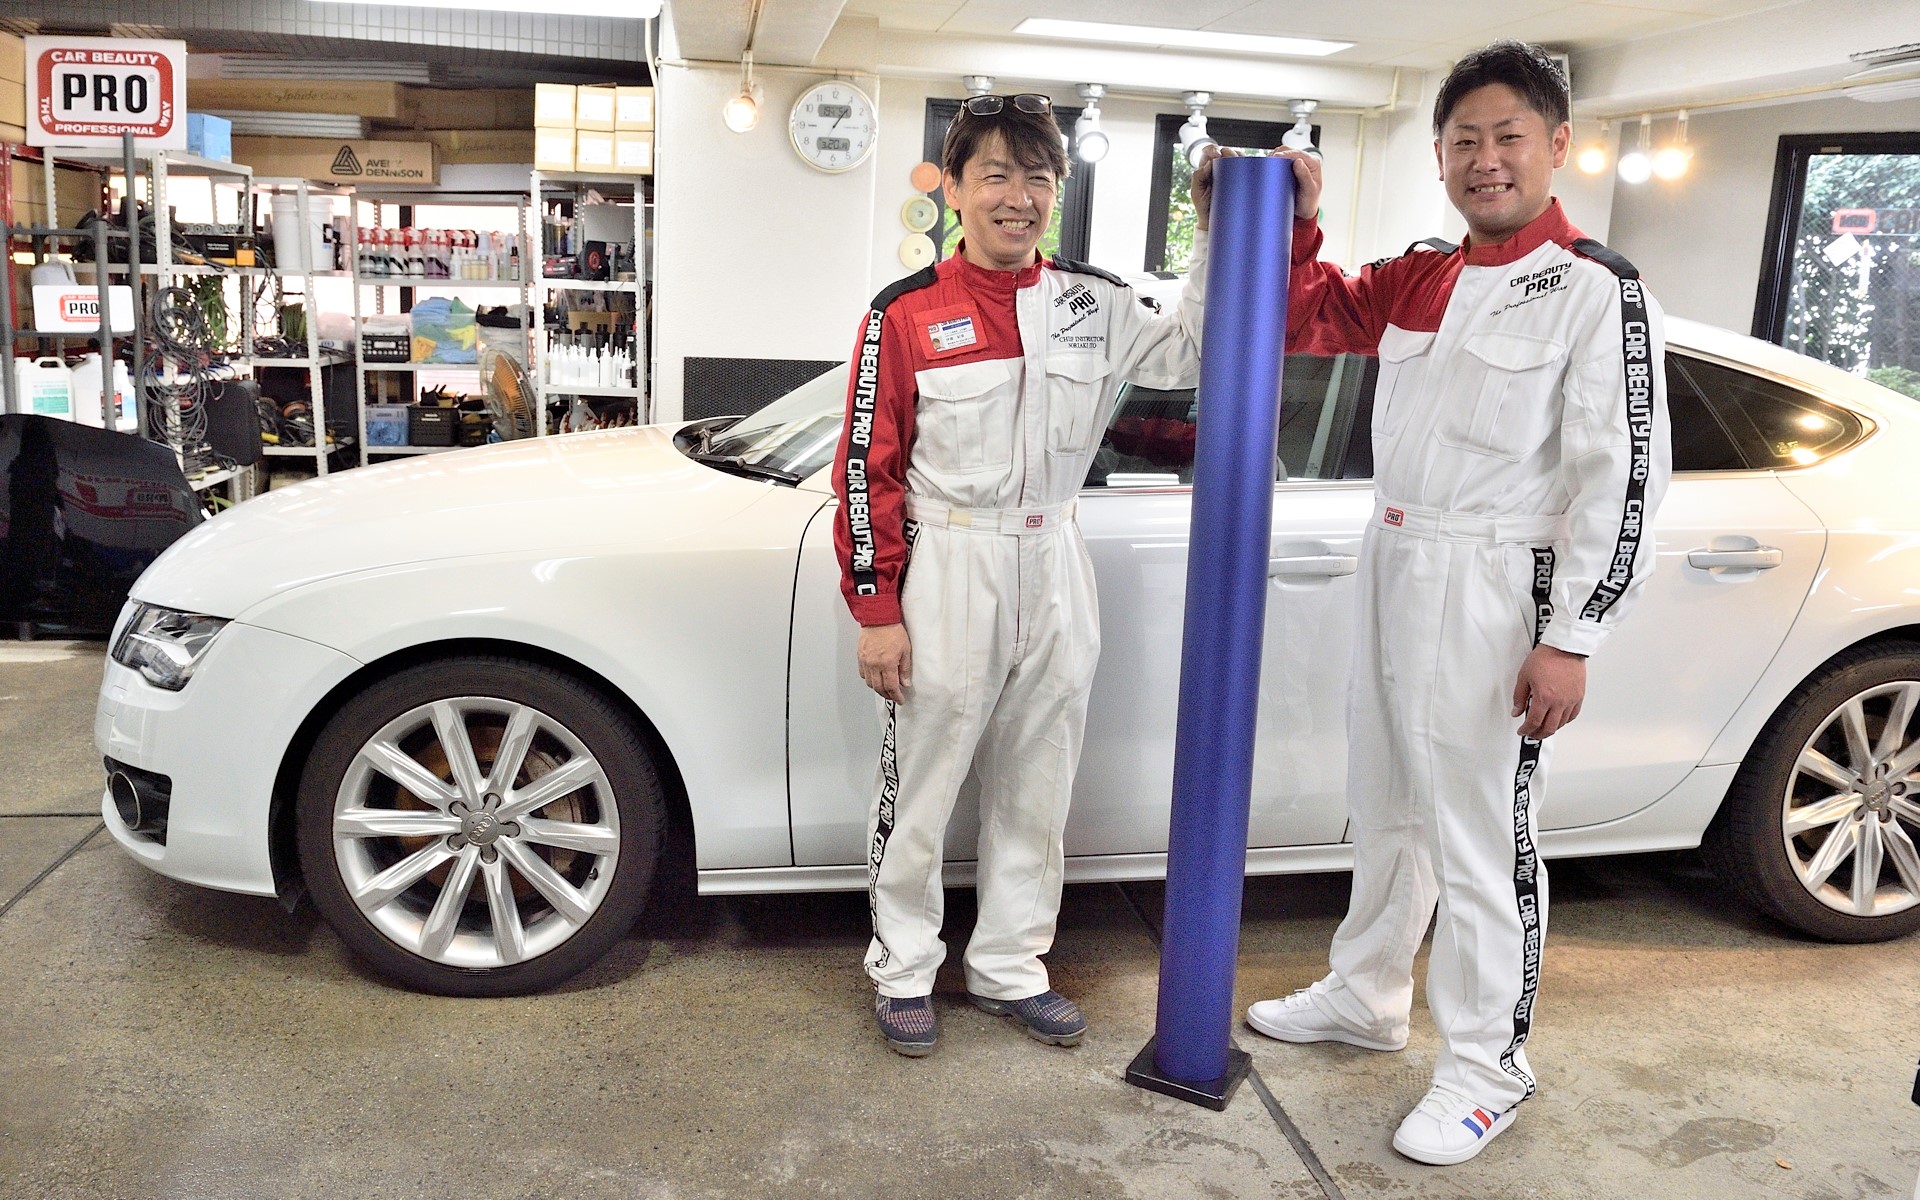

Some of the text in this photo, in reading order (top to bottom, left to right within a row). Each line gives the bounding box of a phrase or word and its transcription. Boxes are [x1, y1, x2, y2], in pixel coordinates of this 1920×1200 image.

[51, 52, 160, 65] CAR BEAUTY
[63, 73, 148, 114] PRO
[40, 97, 52, 125] THE
[159, 100, 171, 128] WAY
[1510, 262, 1572, 288] CAR BEAUTY
[1524, 274, 1562, 296] PRO
[69, 302, 99, 314] PRO
[1054, 283, 1086, 308] CAR BEAUTY
[1068, 290, 1096, 315] PRO
[852, 310, 884, 446] CAR BEAUTY PRO
[1625, 322, 1651, 481] CAR BEAUTY PRO
[848, 458, 868, 491] CAR
[849, 492, 874, 554] BEAUTY
[1387, 512, 1400, 522] PRO
[1621, 500, 1642, 538] CAR
[1535, 552, 1552, 590] PRO
[1582, 589, 1616, 622] PRO
[1516, 759, 1537, 790] CAR
[1514, 793, 1532, 853] BEAUTY
[1517, 853, 1536, 882] PRO
[1515, 893, 1538, 1020] CAR BEAUTY PRO
